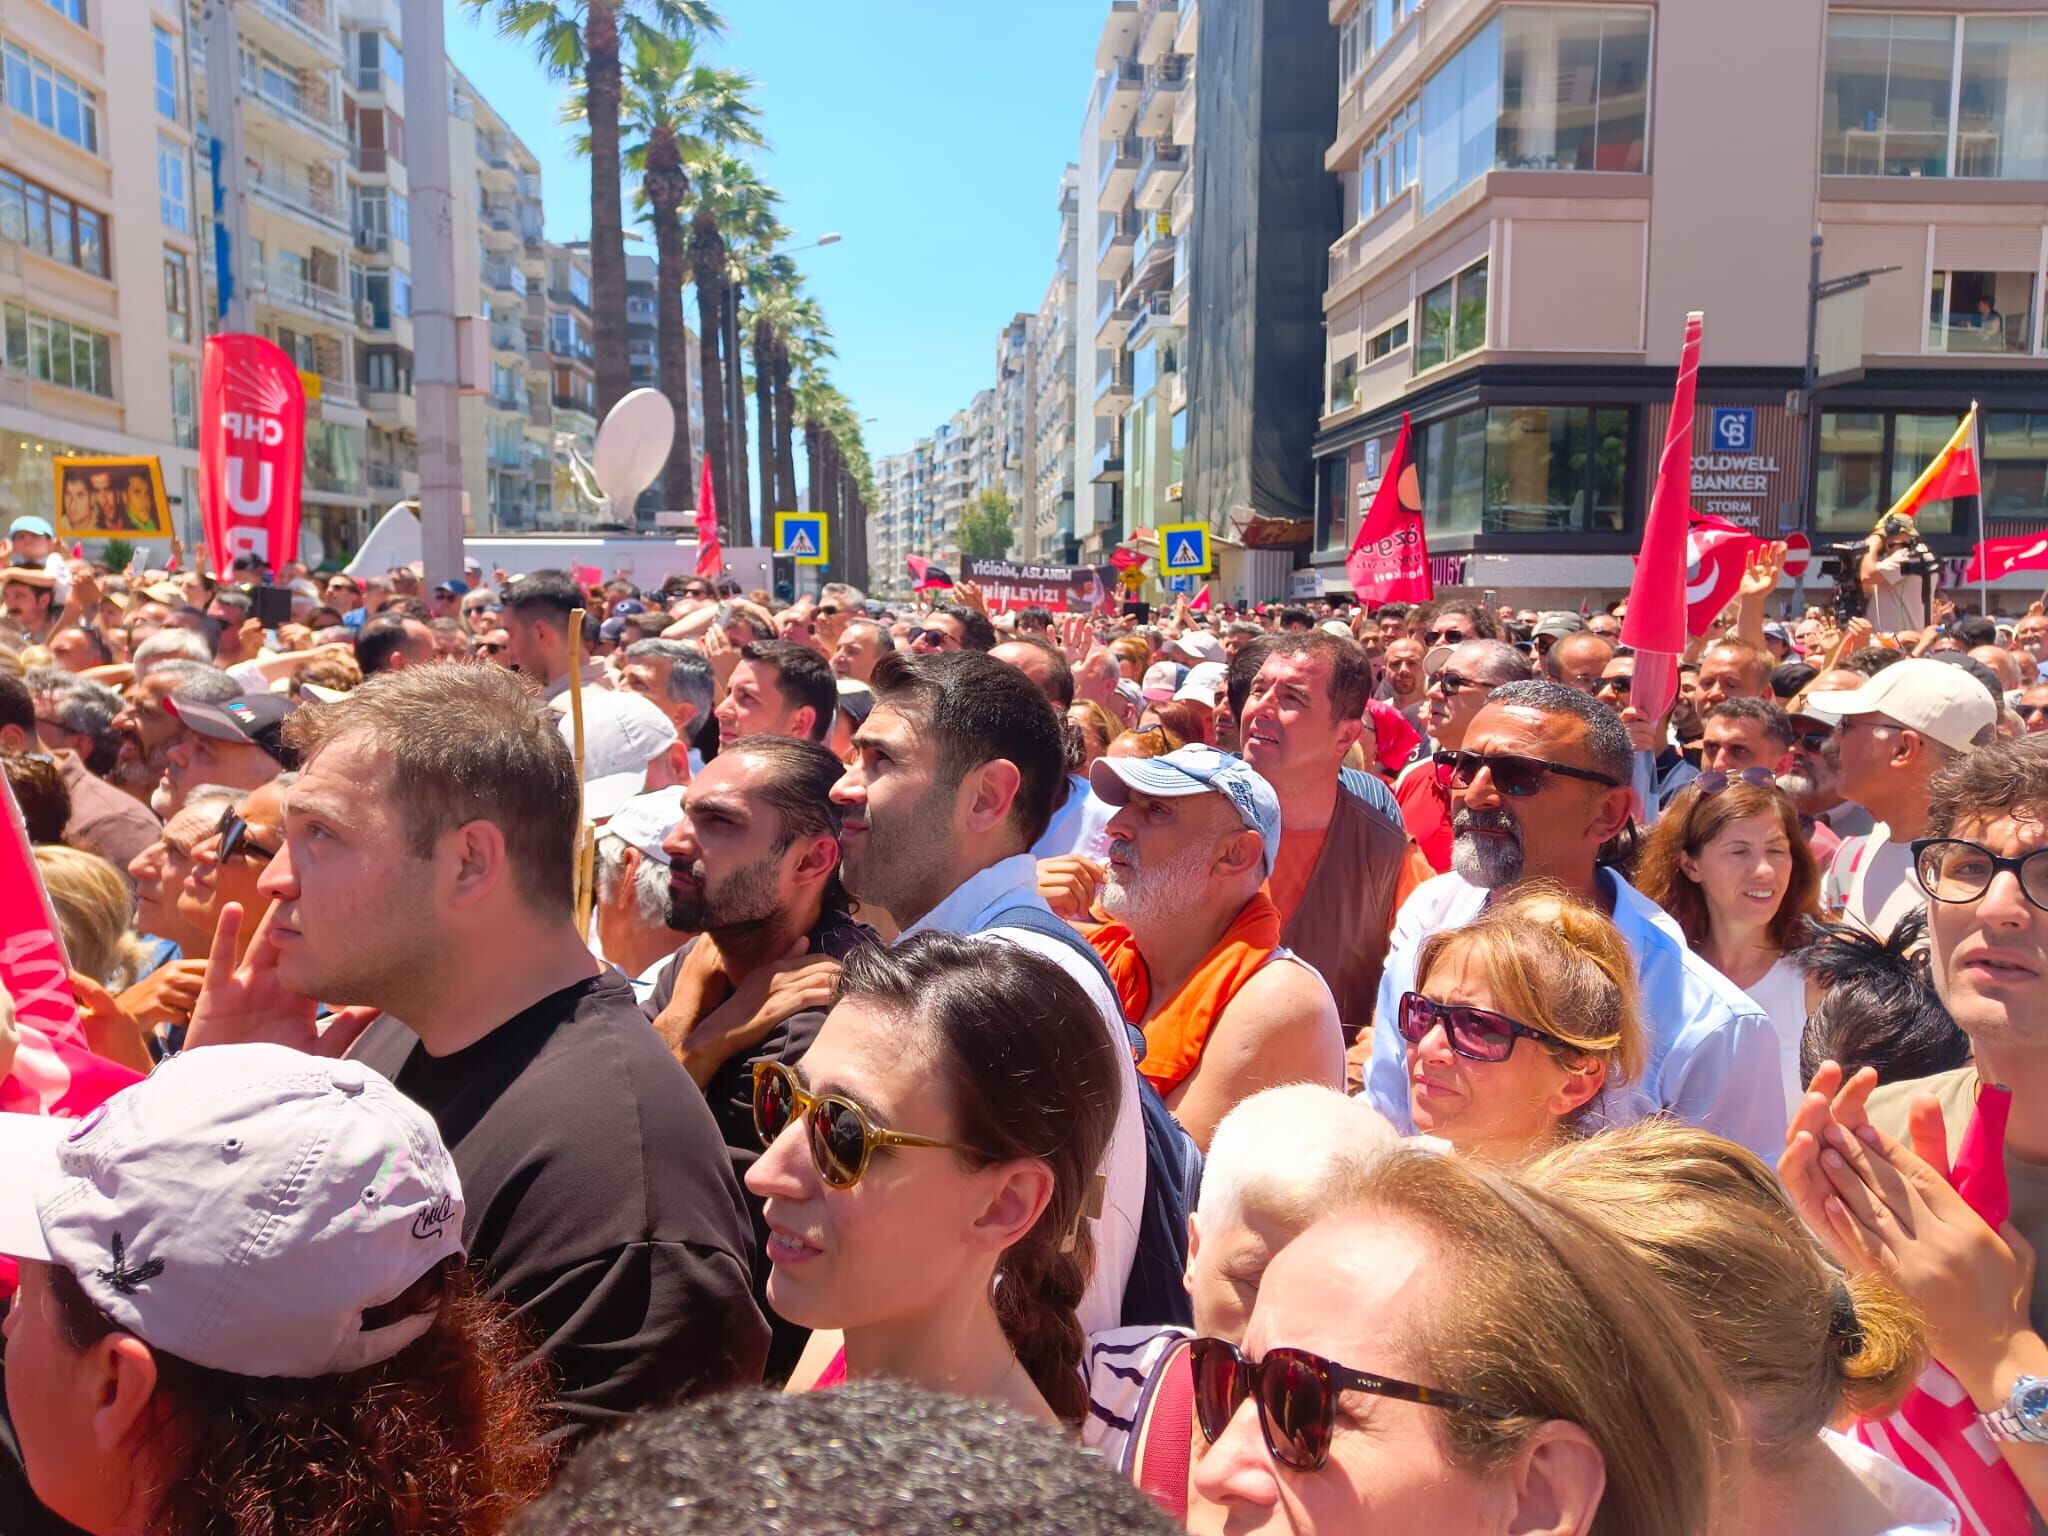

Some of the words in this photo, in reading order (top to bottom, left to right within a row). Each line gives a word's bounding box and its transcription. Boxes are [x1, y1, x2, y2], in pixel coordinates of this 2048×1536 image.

[1691, 475, 1767, 490] BANKER
[1706, 501, 1752, 513] STORM
[1021, 566, 1072, 581] ASLANIM
